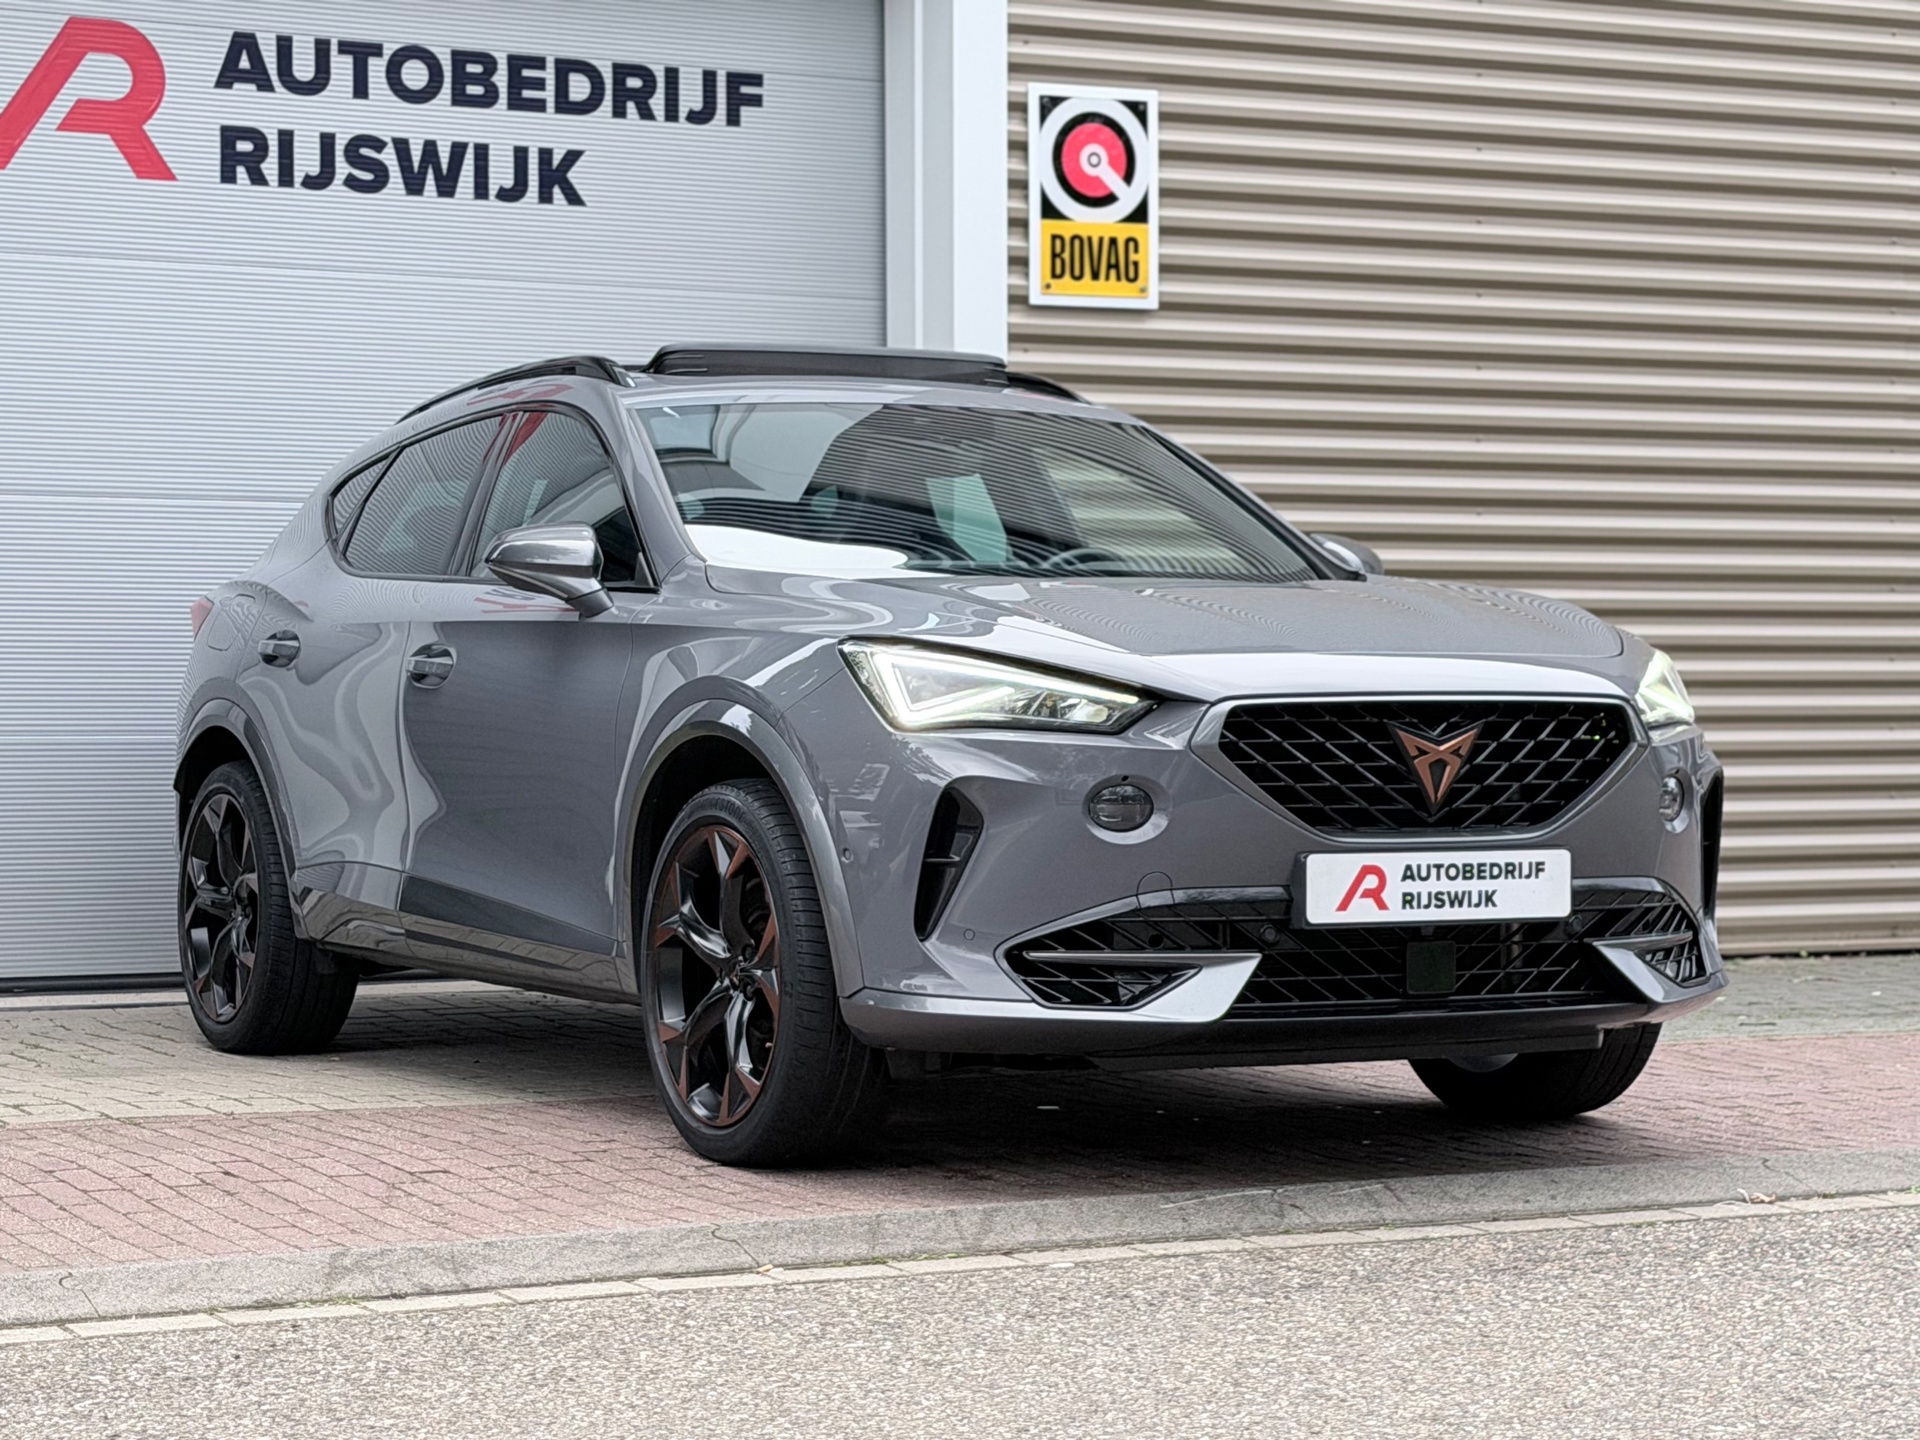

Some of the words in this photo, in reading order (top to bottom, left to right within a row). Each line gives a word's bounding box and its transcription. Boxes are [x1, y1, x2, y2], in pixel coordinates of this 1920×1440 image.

[214, 31, 764, 127] AUTOBEDRIJF
[220, 125, 587, 206] RIJSWIJK
[1050, 233, 1140, 283] BOVAG
[1400, 861, 1546, 882] AUTOBEDRIJF
[1401, 889, 1498, 910] RIJSWIJK
